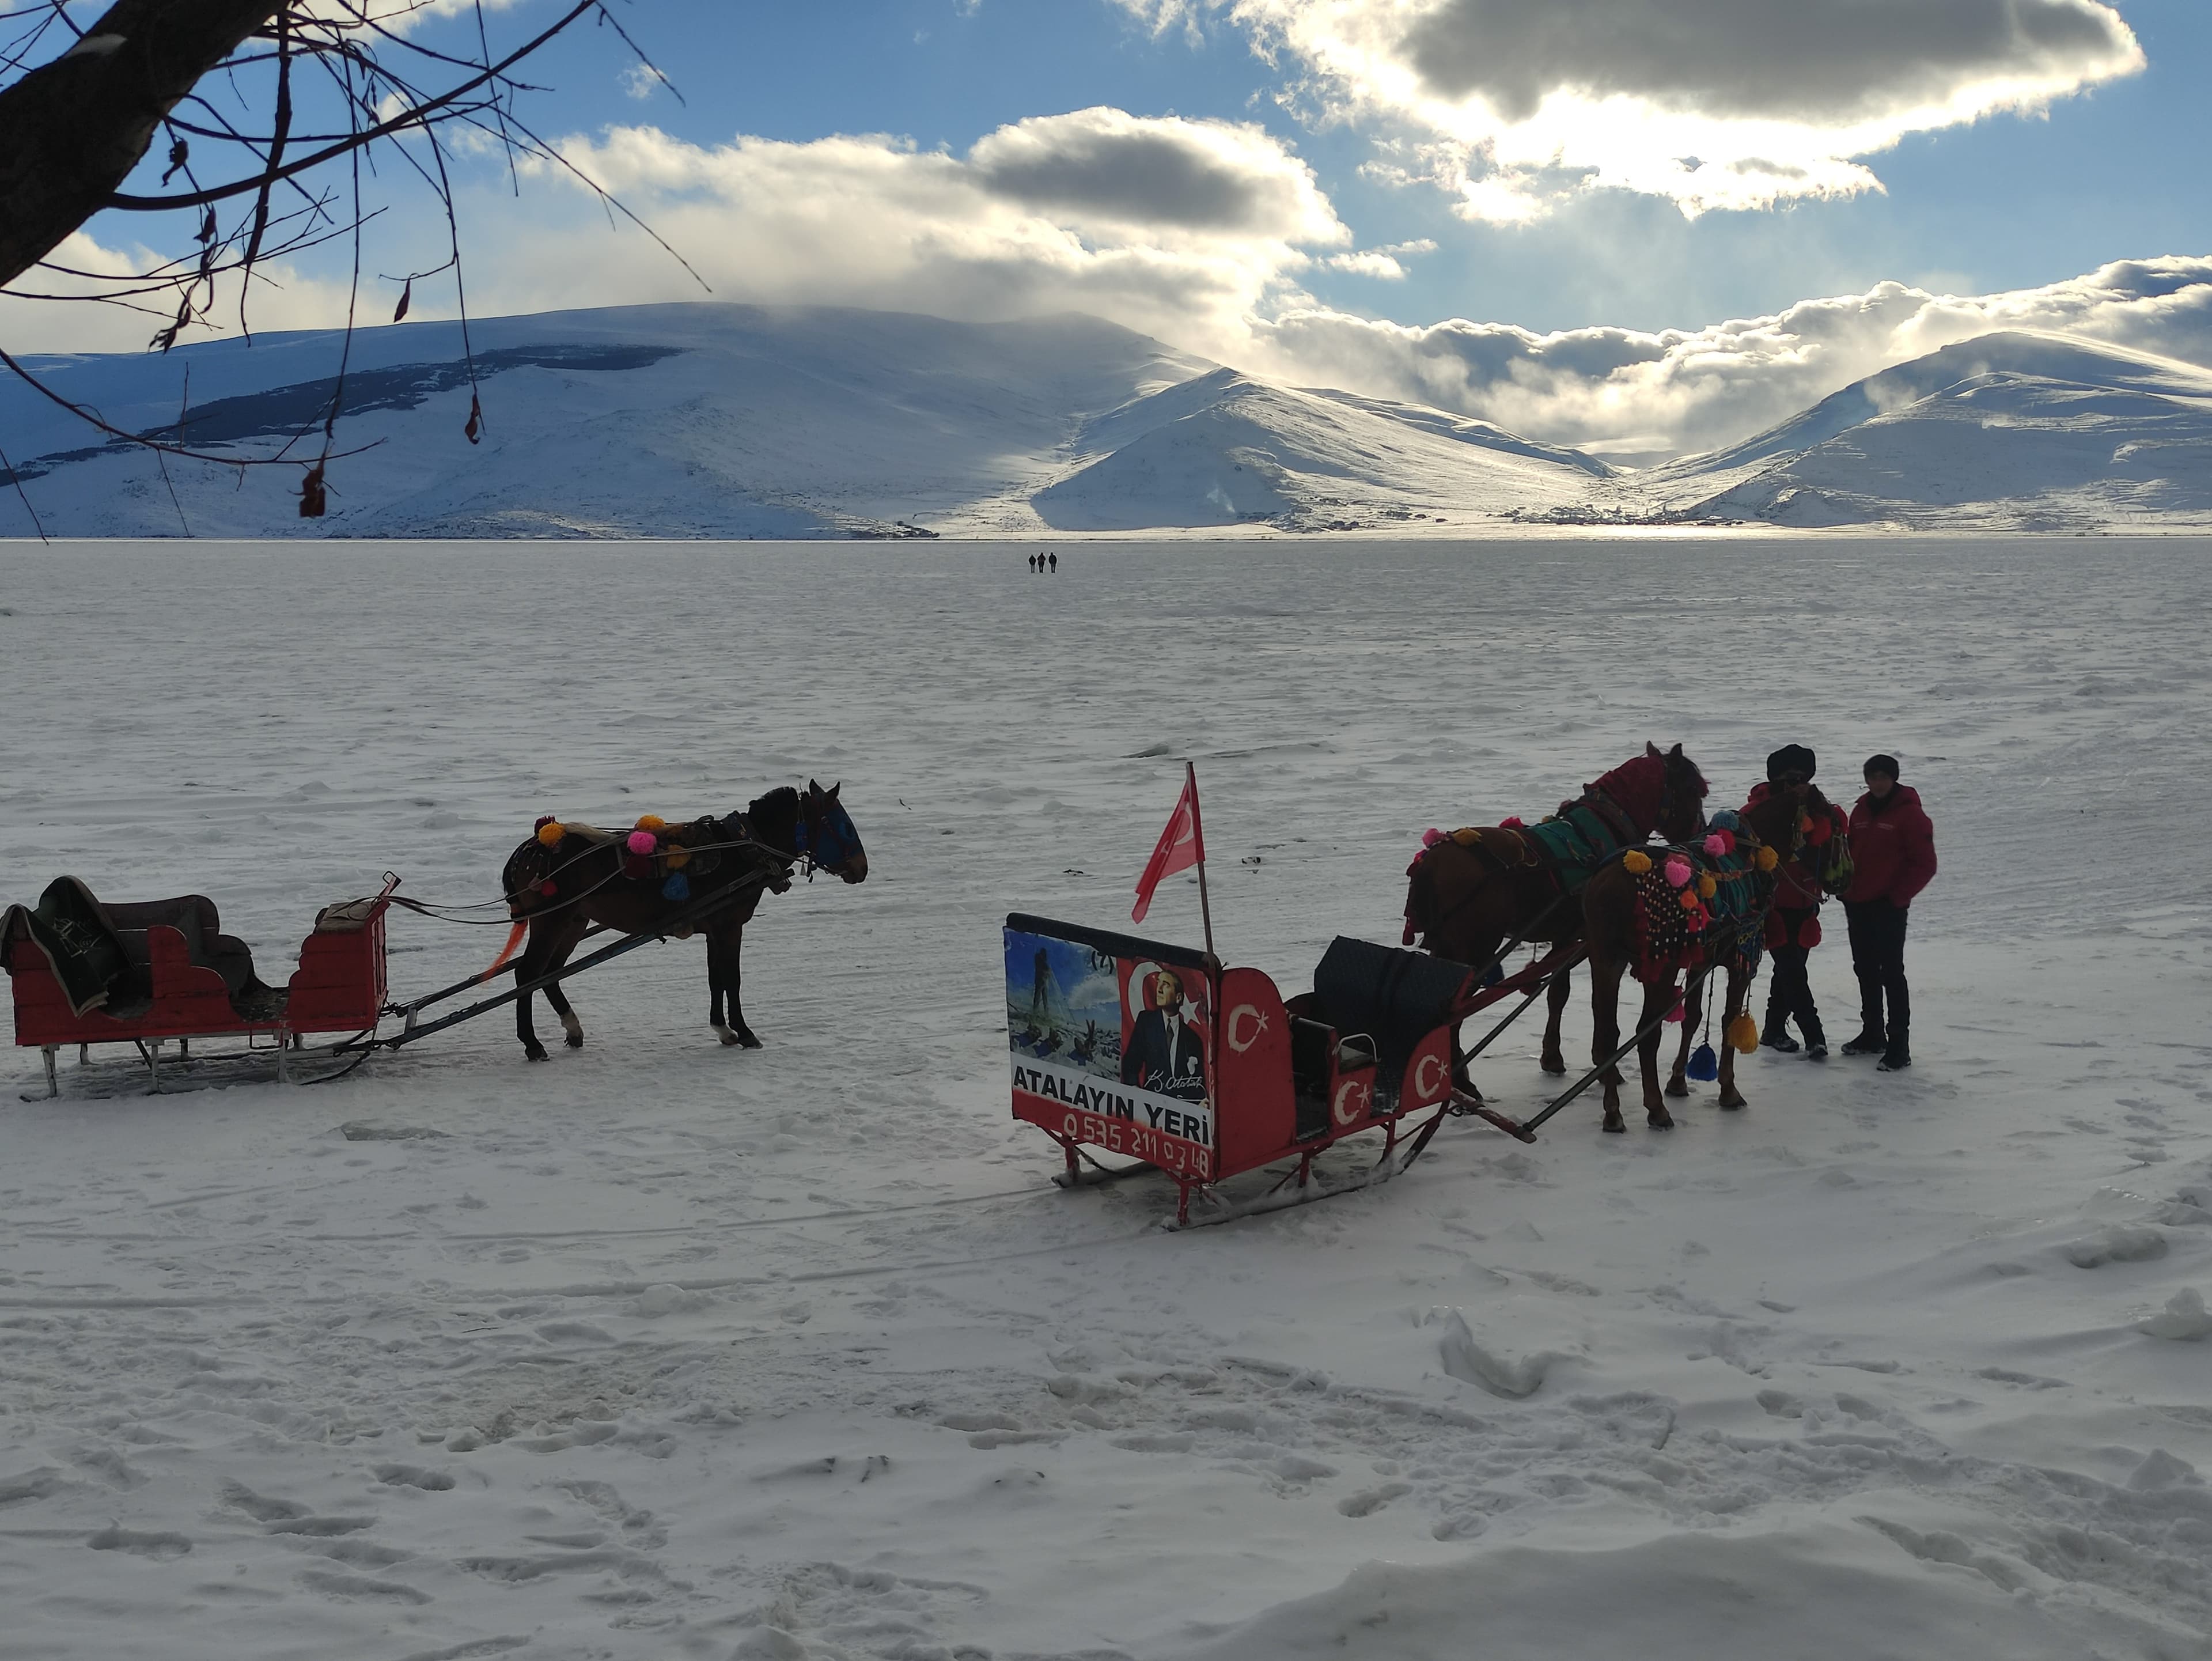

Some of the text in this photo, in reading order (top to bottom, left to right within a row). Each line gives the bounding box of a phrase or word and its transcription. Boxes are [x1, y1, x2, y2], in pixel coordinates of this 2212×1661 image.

[1013, 1066, 1209, 1145] ATALAYIN YERİ
[1084, 1116, 1122, 1150] 535
